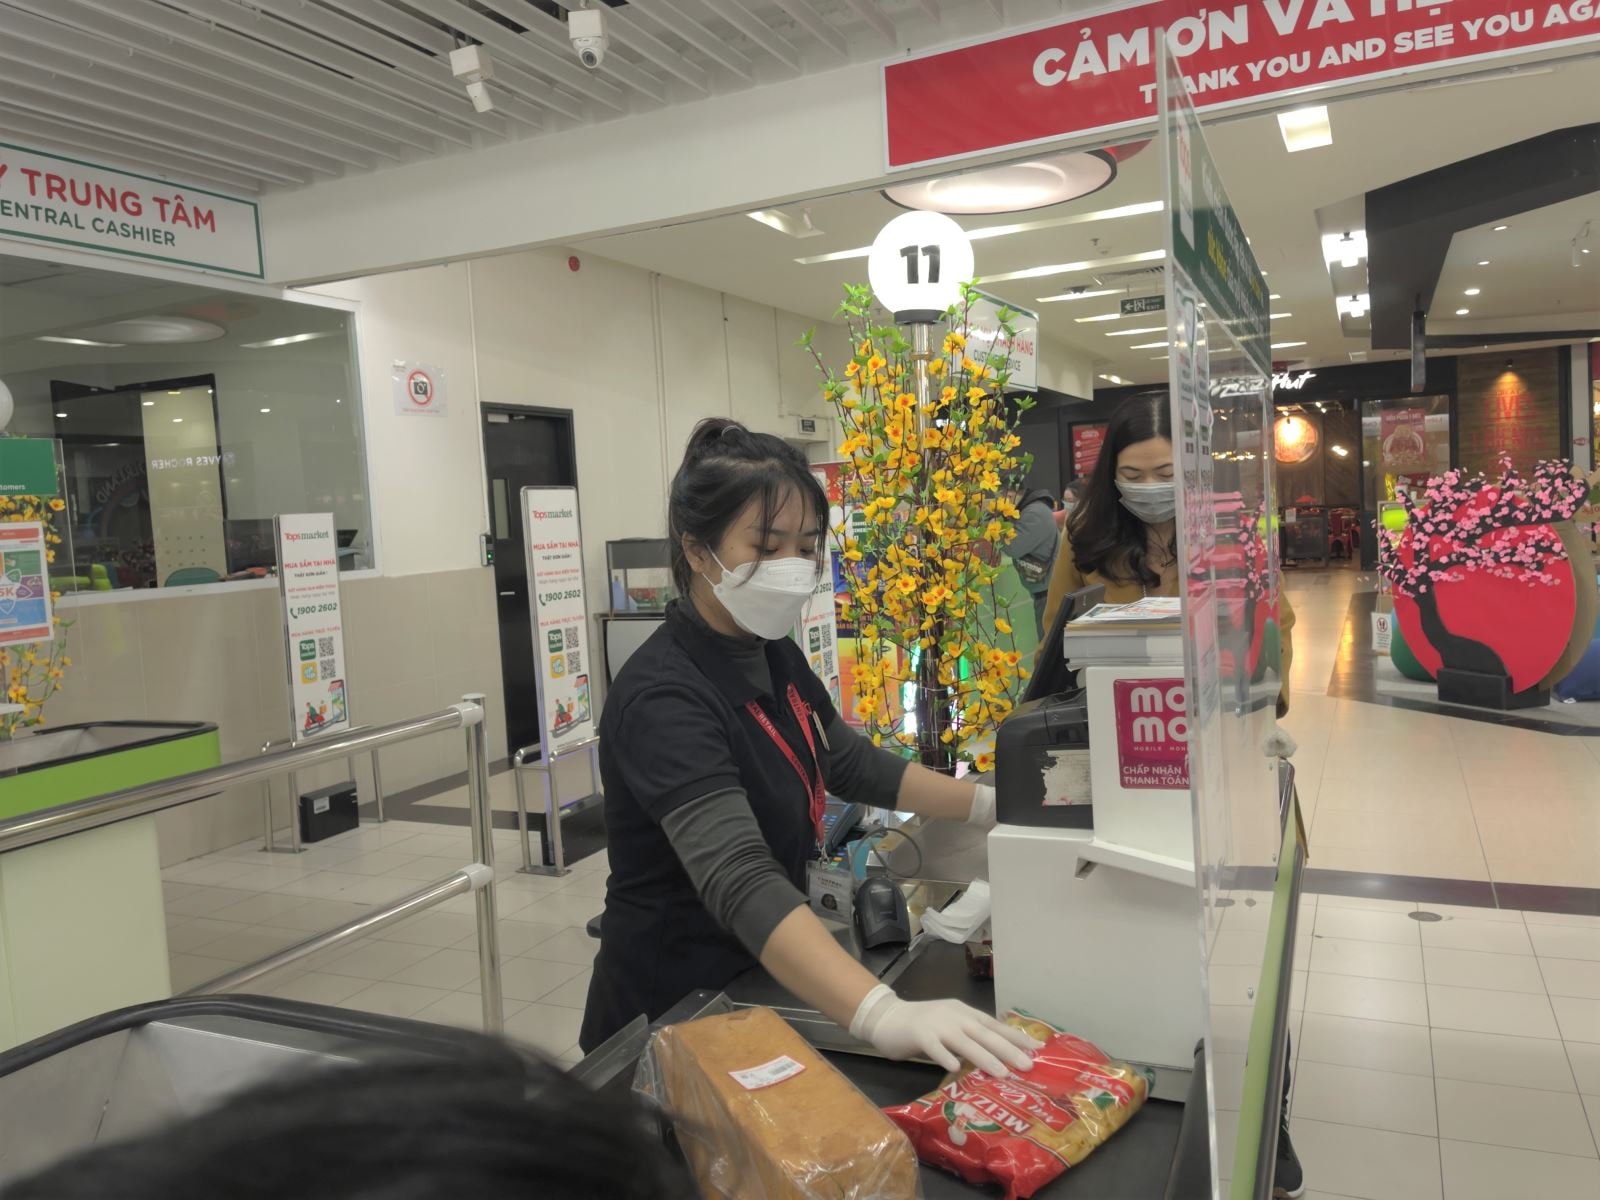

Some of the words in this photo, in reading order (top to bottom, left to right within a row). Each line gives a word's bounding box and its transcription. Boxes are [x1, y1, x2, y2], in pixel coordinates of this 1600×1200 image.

[1032, 26, 1150, 87] CẢM
[1165, 9, 1250, 58] ƠN
[1139, 65, 1240, 104] TANK
[1246, 51, 1311, 83] YOU
[1319, 37, 1386, 69] AND
[1393, 23, 1454, 55] SEE
[1462, 8, 1534, 41] YOU
[1543, 0, 1600, 28] AG
[20, 167, 143, 217] TRUNG
[152, 194, 216, 233] TÂM
[92, 217, 176, 247] CASHIER
[899, 245, 941, 284] 11
[1271, 370, 1317, 392] Hut
[297, 605, 316, 616] 1900
[318, 603, 338, 613] 2602
[545, 592, 562, 602] 1900
[563, 589, 581, 600] 2602
[1122, 763, 1149, 775] CHẤP
[1124, 776, 1159, 785] THANH
[943, 1081, 1032, 1134] MEIZAN
